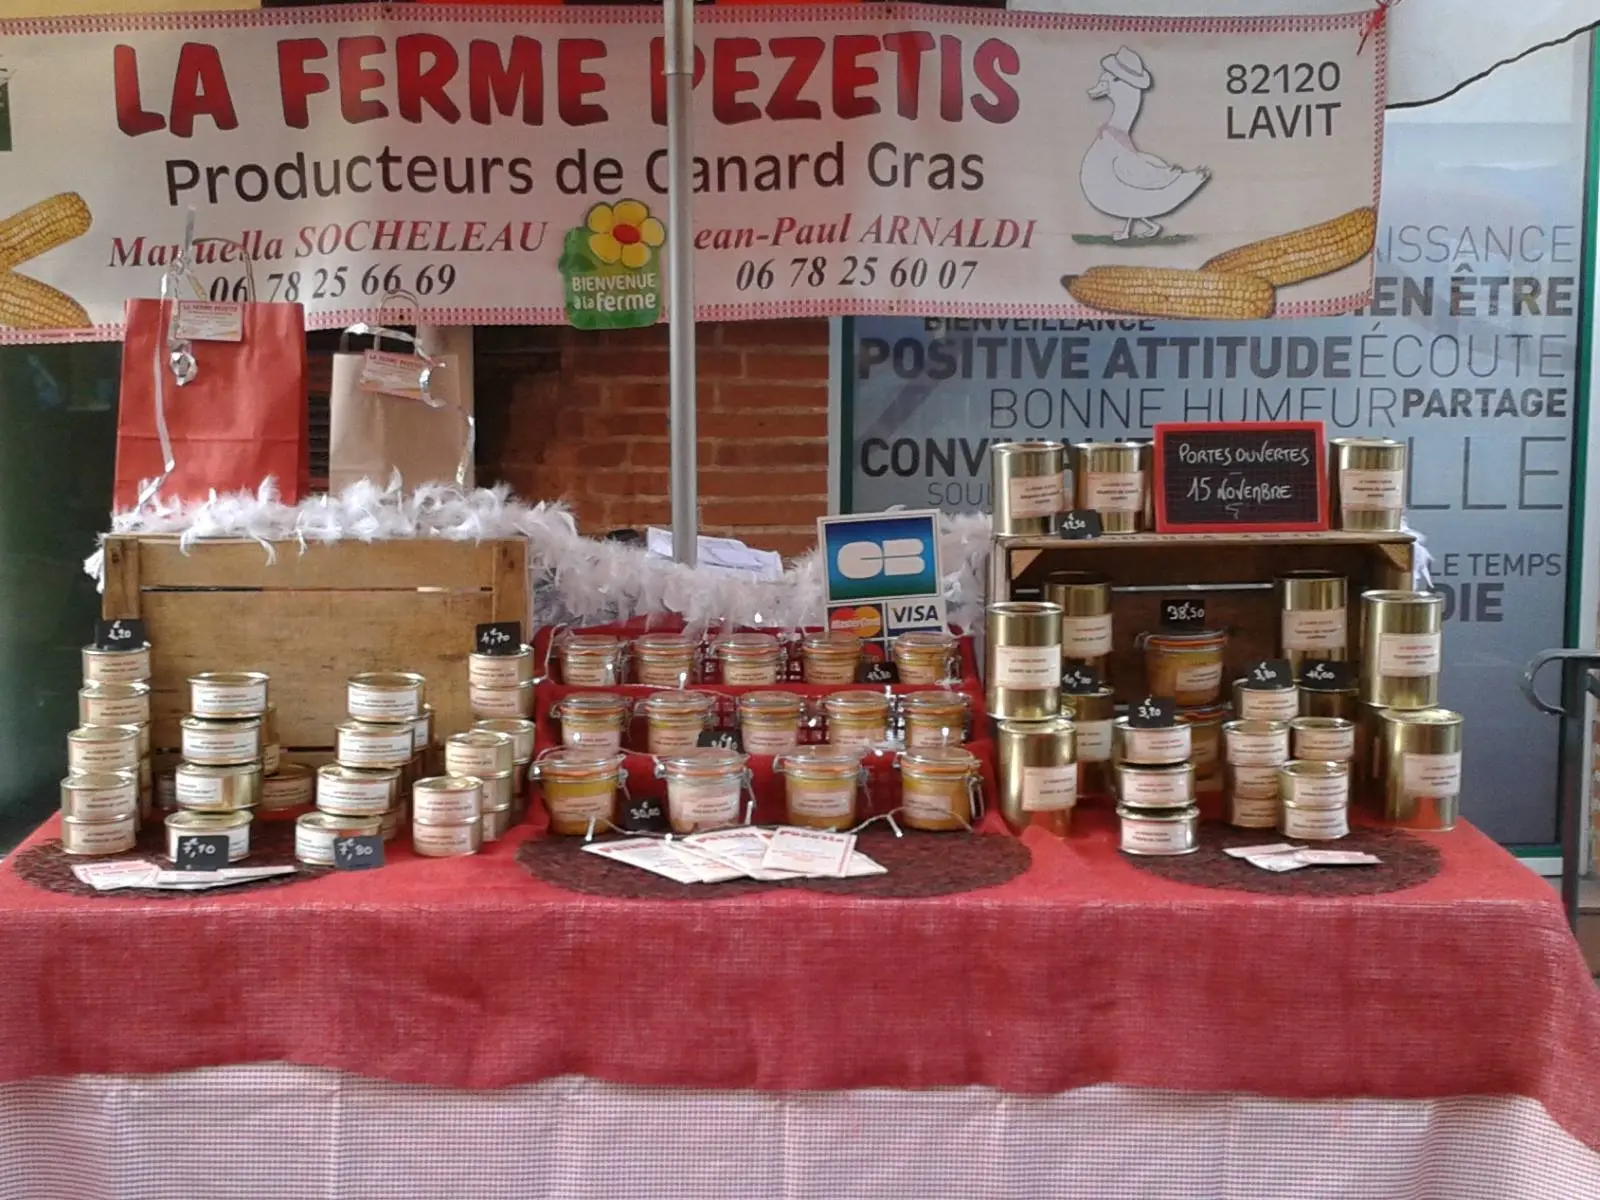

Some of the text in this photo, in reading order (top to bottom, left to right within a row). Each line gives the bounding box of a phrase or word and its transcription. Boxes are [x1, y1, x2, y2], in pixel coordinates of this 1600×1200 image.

[113, 43, 239, 137] LA
[277, 34, 608, 131] FERME
[1226, 61, 1342, 95] 82120
[1226, 102, 1342, 140] LAVIT
[165, 141, 985, 207] Producteurs de Canard Gras
[294, 219, 548, 259] SOCHELEAU
[694, 213, 1037, 250] ean-Paul ARNALDI
[209, 263, 457, 303] 06 78 25 66 69
[571, 272, 657, 292] BIENVENUE
[736, 256, 978, 292] 06 78 25 60 07
[1356, 262, 1575, 317] EN ÊTRE
[596, 292, 657, 312] ferme
[858, 321, 1567, 380] POSITIVE ATTITUDE ÉCOUTE
[990, 385, 1568, 430] BONNE HUMEUR PARTAGE
[1178, 440, 1310, 467] PORTES OUVERTES
[1186, 476, 1213, 502] 15
[1428, 552, 1562, 578] LE TEMPS
[892, 604, 939, 623] VISA
